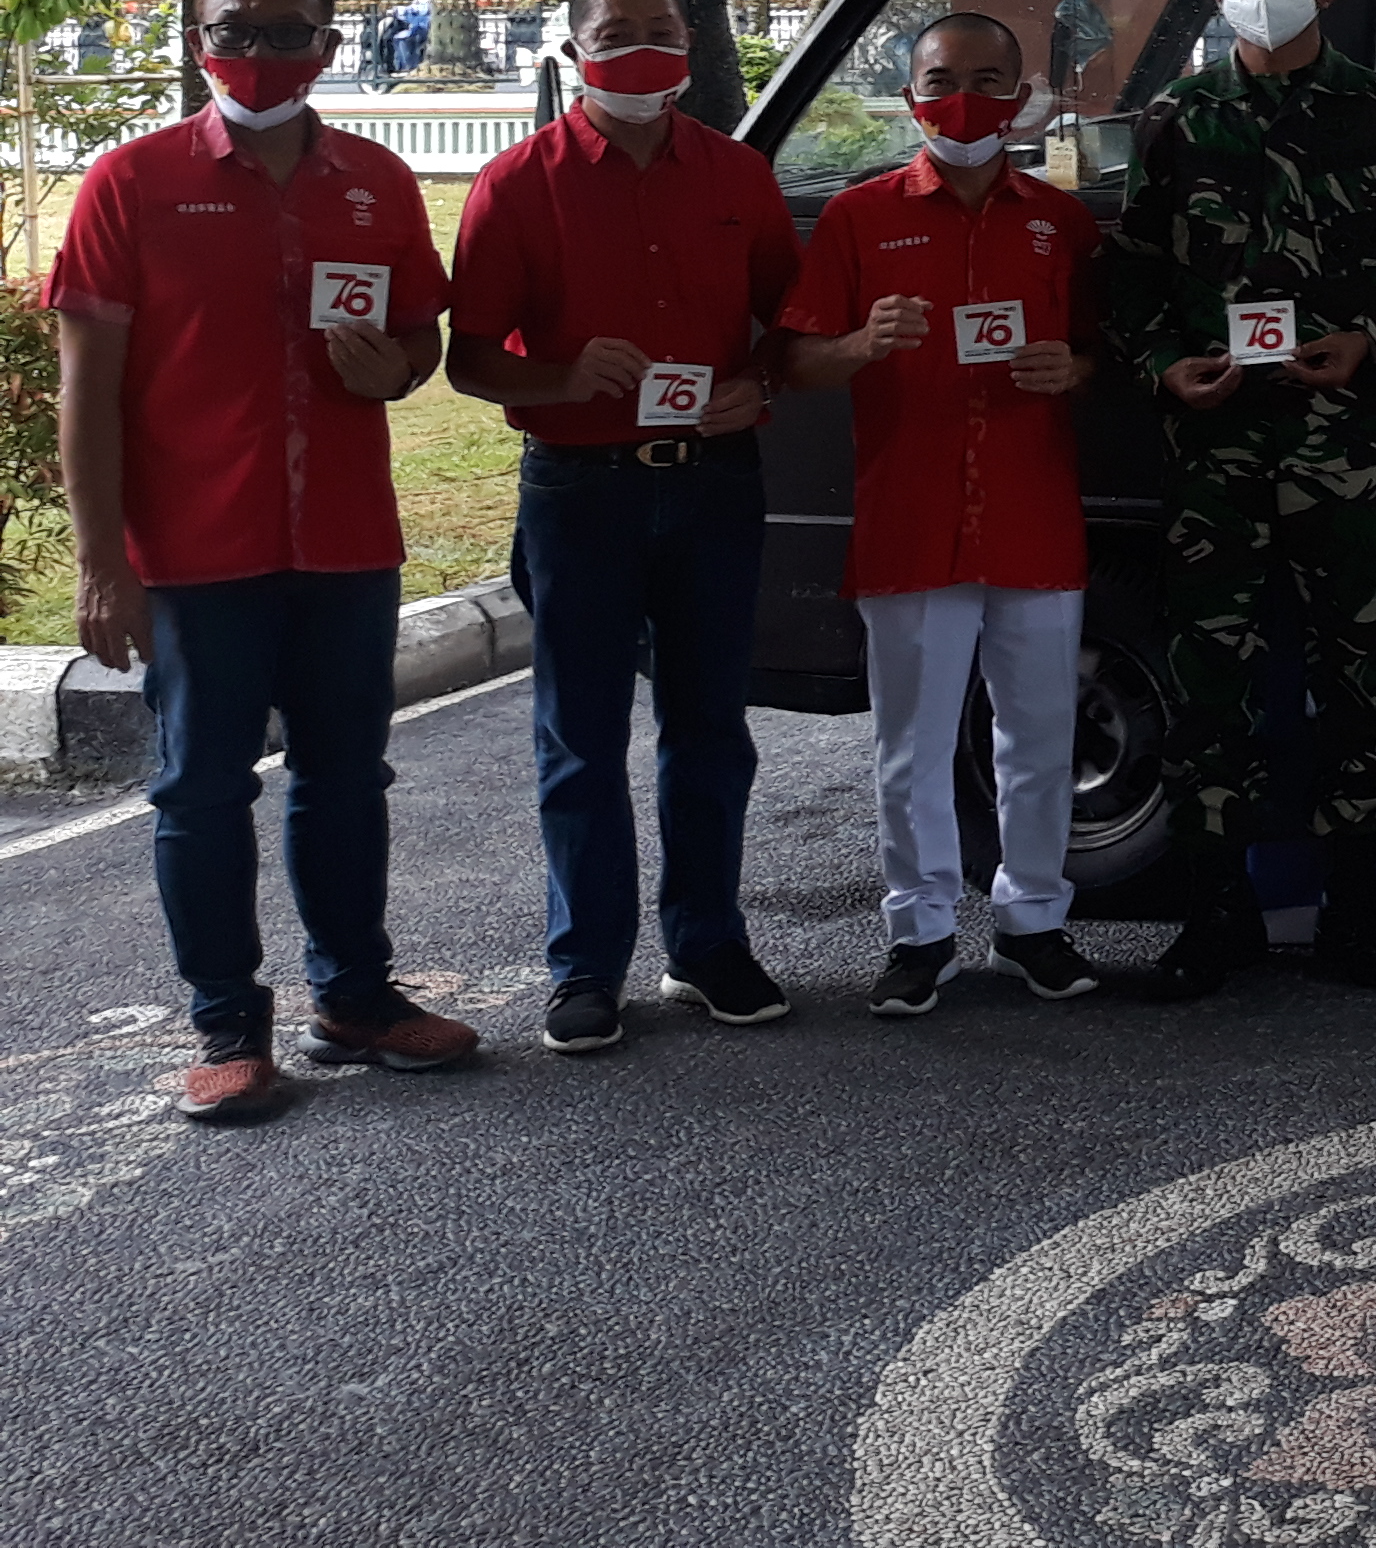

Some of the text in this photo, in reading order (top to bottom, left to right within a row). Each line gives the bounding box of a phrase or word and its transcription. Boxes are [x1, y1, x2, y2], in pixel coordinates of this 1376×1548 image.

[326, 273, 374, 316] 76
[965, 311, 1012, 346] 76
[1239, 313, 1283, 349] 76
[654, 373, 697, 411] 76
